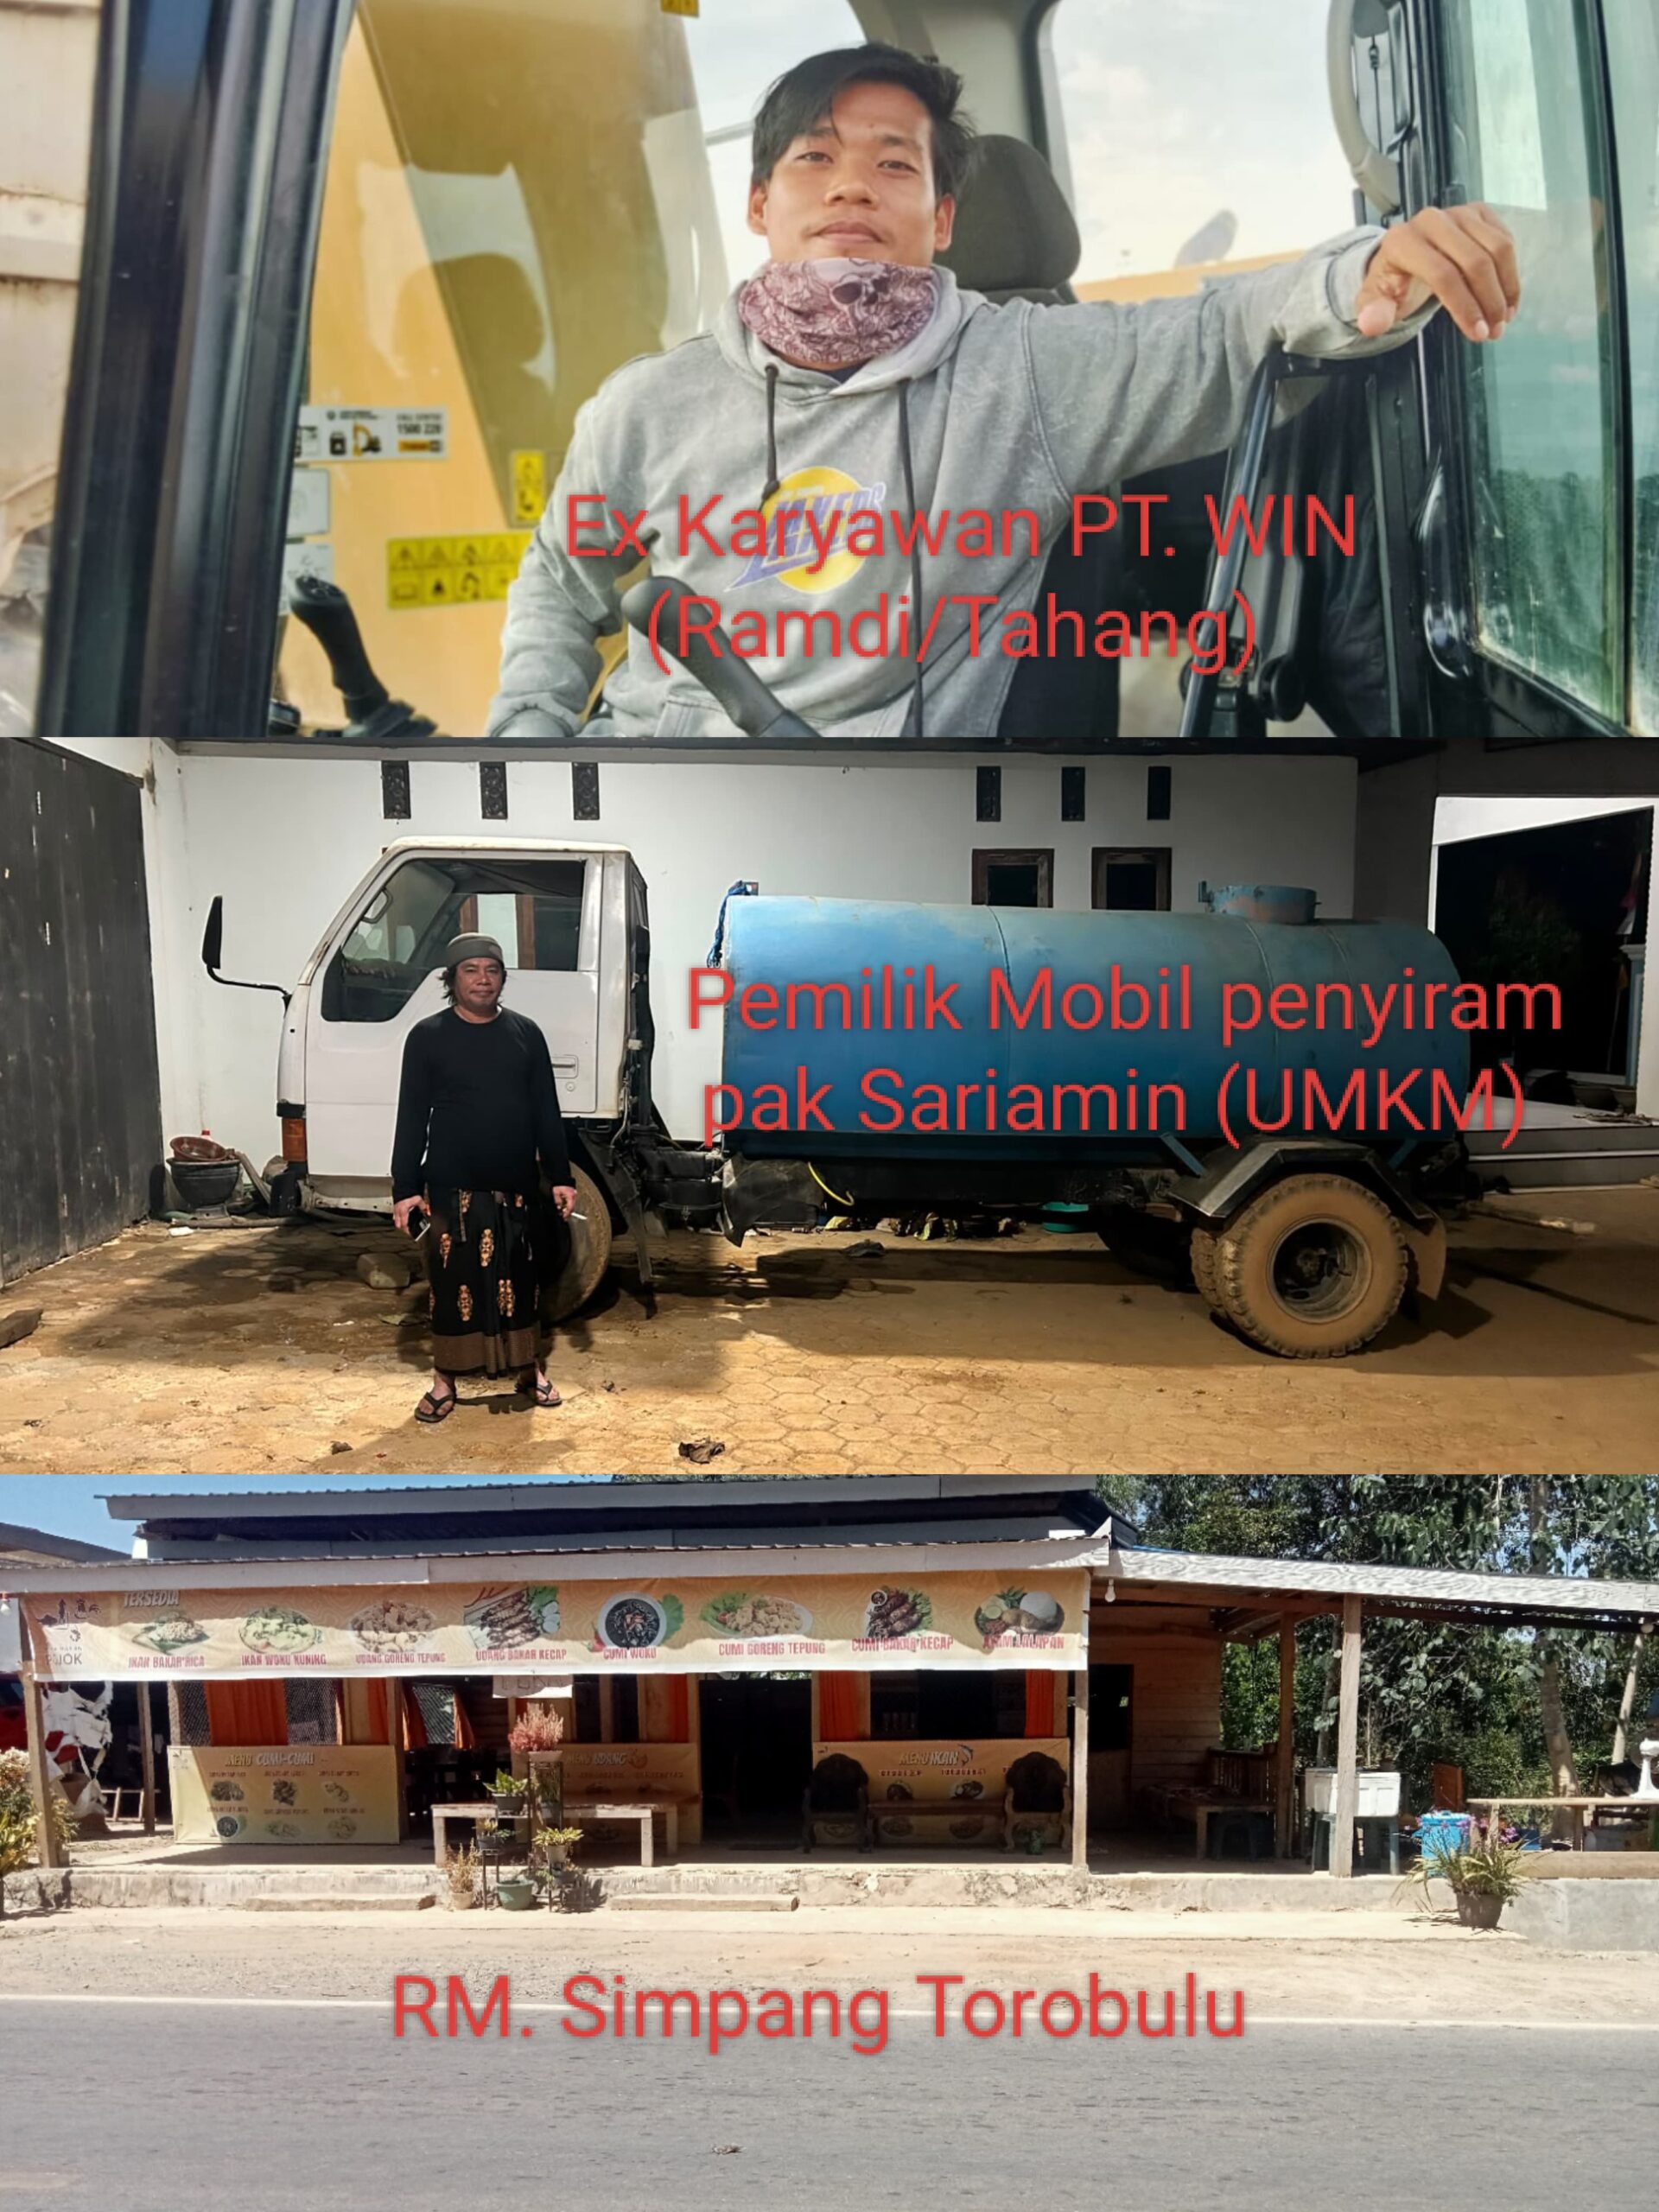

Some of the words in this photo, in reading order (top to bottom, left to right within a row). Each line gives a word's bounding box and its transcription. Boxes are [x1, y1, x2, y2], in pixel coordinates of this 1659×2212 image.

[124, 1590, 180, 1608] TERSEDIA
[719, 1643, 744, 1656] CUMI
[747, 1643, 785, 1655] GORENG
[787, 1643, 826, 1654] TEPUNG
[851, 1638, 880, 1651] CUMI
[883, 1637, 916, 1651] BAKAR
[919, 1637, 954, 1650] KECAP
[241, 1654, 263, 1666] IKAN
[294, 1654, 327, 1666] KUNING
[356, 1654, 382, 1664] UDANG
[385, 1654, 415, 1663] GORENG
[417, 1653, 446, 1663] TEPUNG
[476, 1649, 505, 1661] UDANG
[507, 1649, 537, 1660] BAKAR
[539, 1649, 567, 1660] KECAP
[603, 1648, 628, 1660] CUMI
[129, 1656, 149, 1668] IKAN
